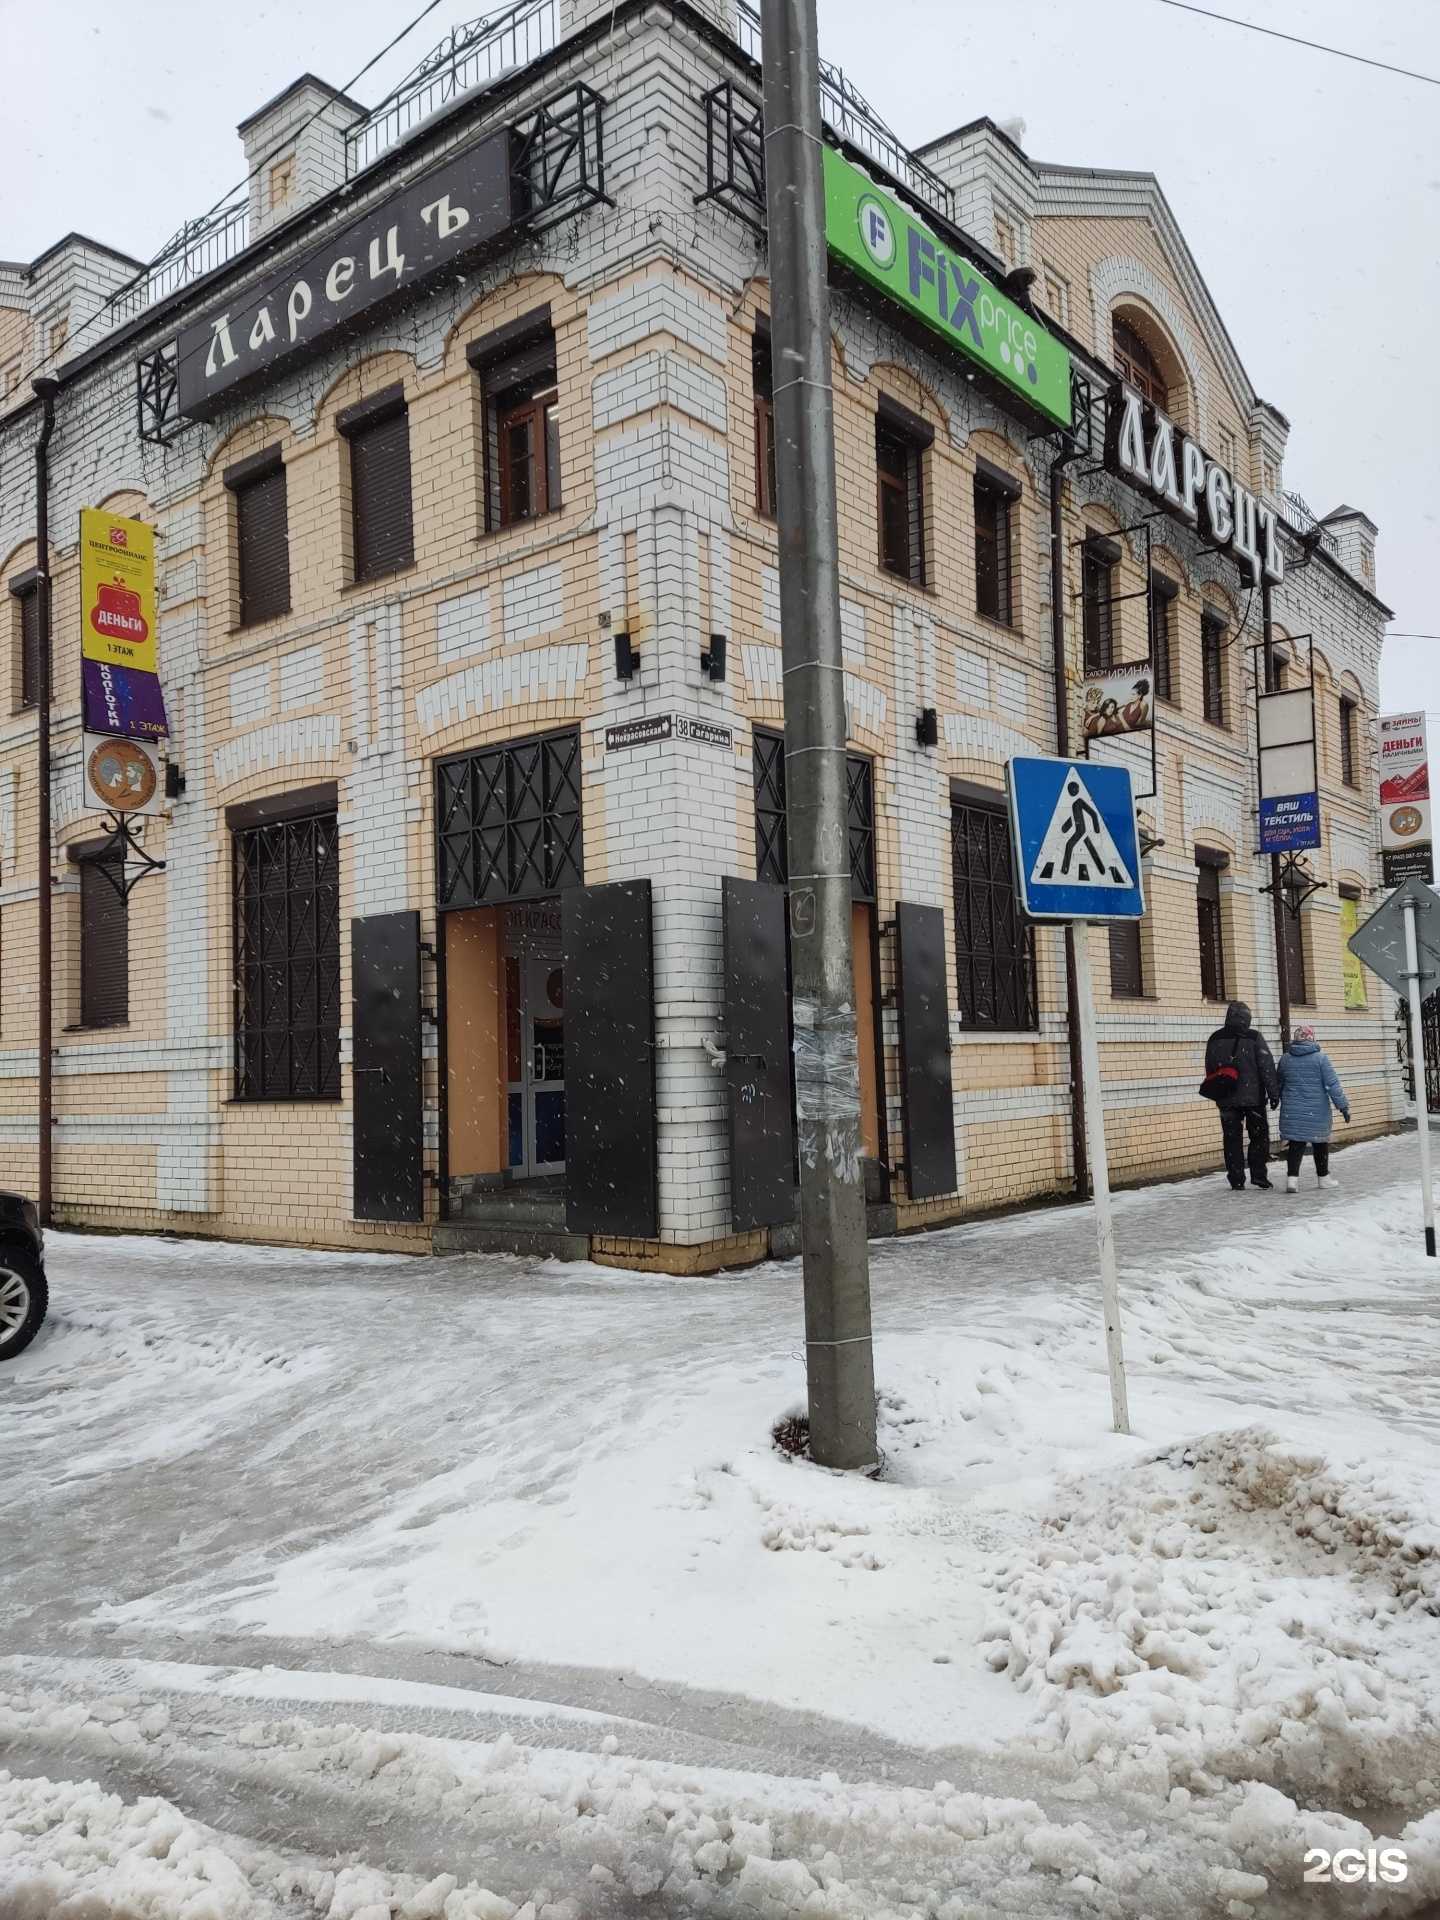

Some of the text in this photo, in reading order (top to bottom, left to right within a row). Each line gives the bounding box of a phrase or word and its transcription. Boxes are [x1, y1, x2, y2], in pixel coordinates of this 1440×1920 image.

[981, 294, 1038, 361] price
[98, 610, 142, 632] ДЕНЬГИ
[113, 645, 134, 657] ЭТАЖ
[1108, 663, 1151, 681] ИРИНА
[129, 720, 167, 733] 1 ЭТАЖ
[678, 719, 689, 737] 38
[691, 724, 730, 744] Гагарина
[1383, 735, 1423, 753] ДЕНЬГИ
[1383, 748, 1424, 759] НАЛИЧНЫМИ
[1276, 801, 1300, 812] ВАШ
[1264, 812, 1314, 826] ТЕКСТИЛЬ
